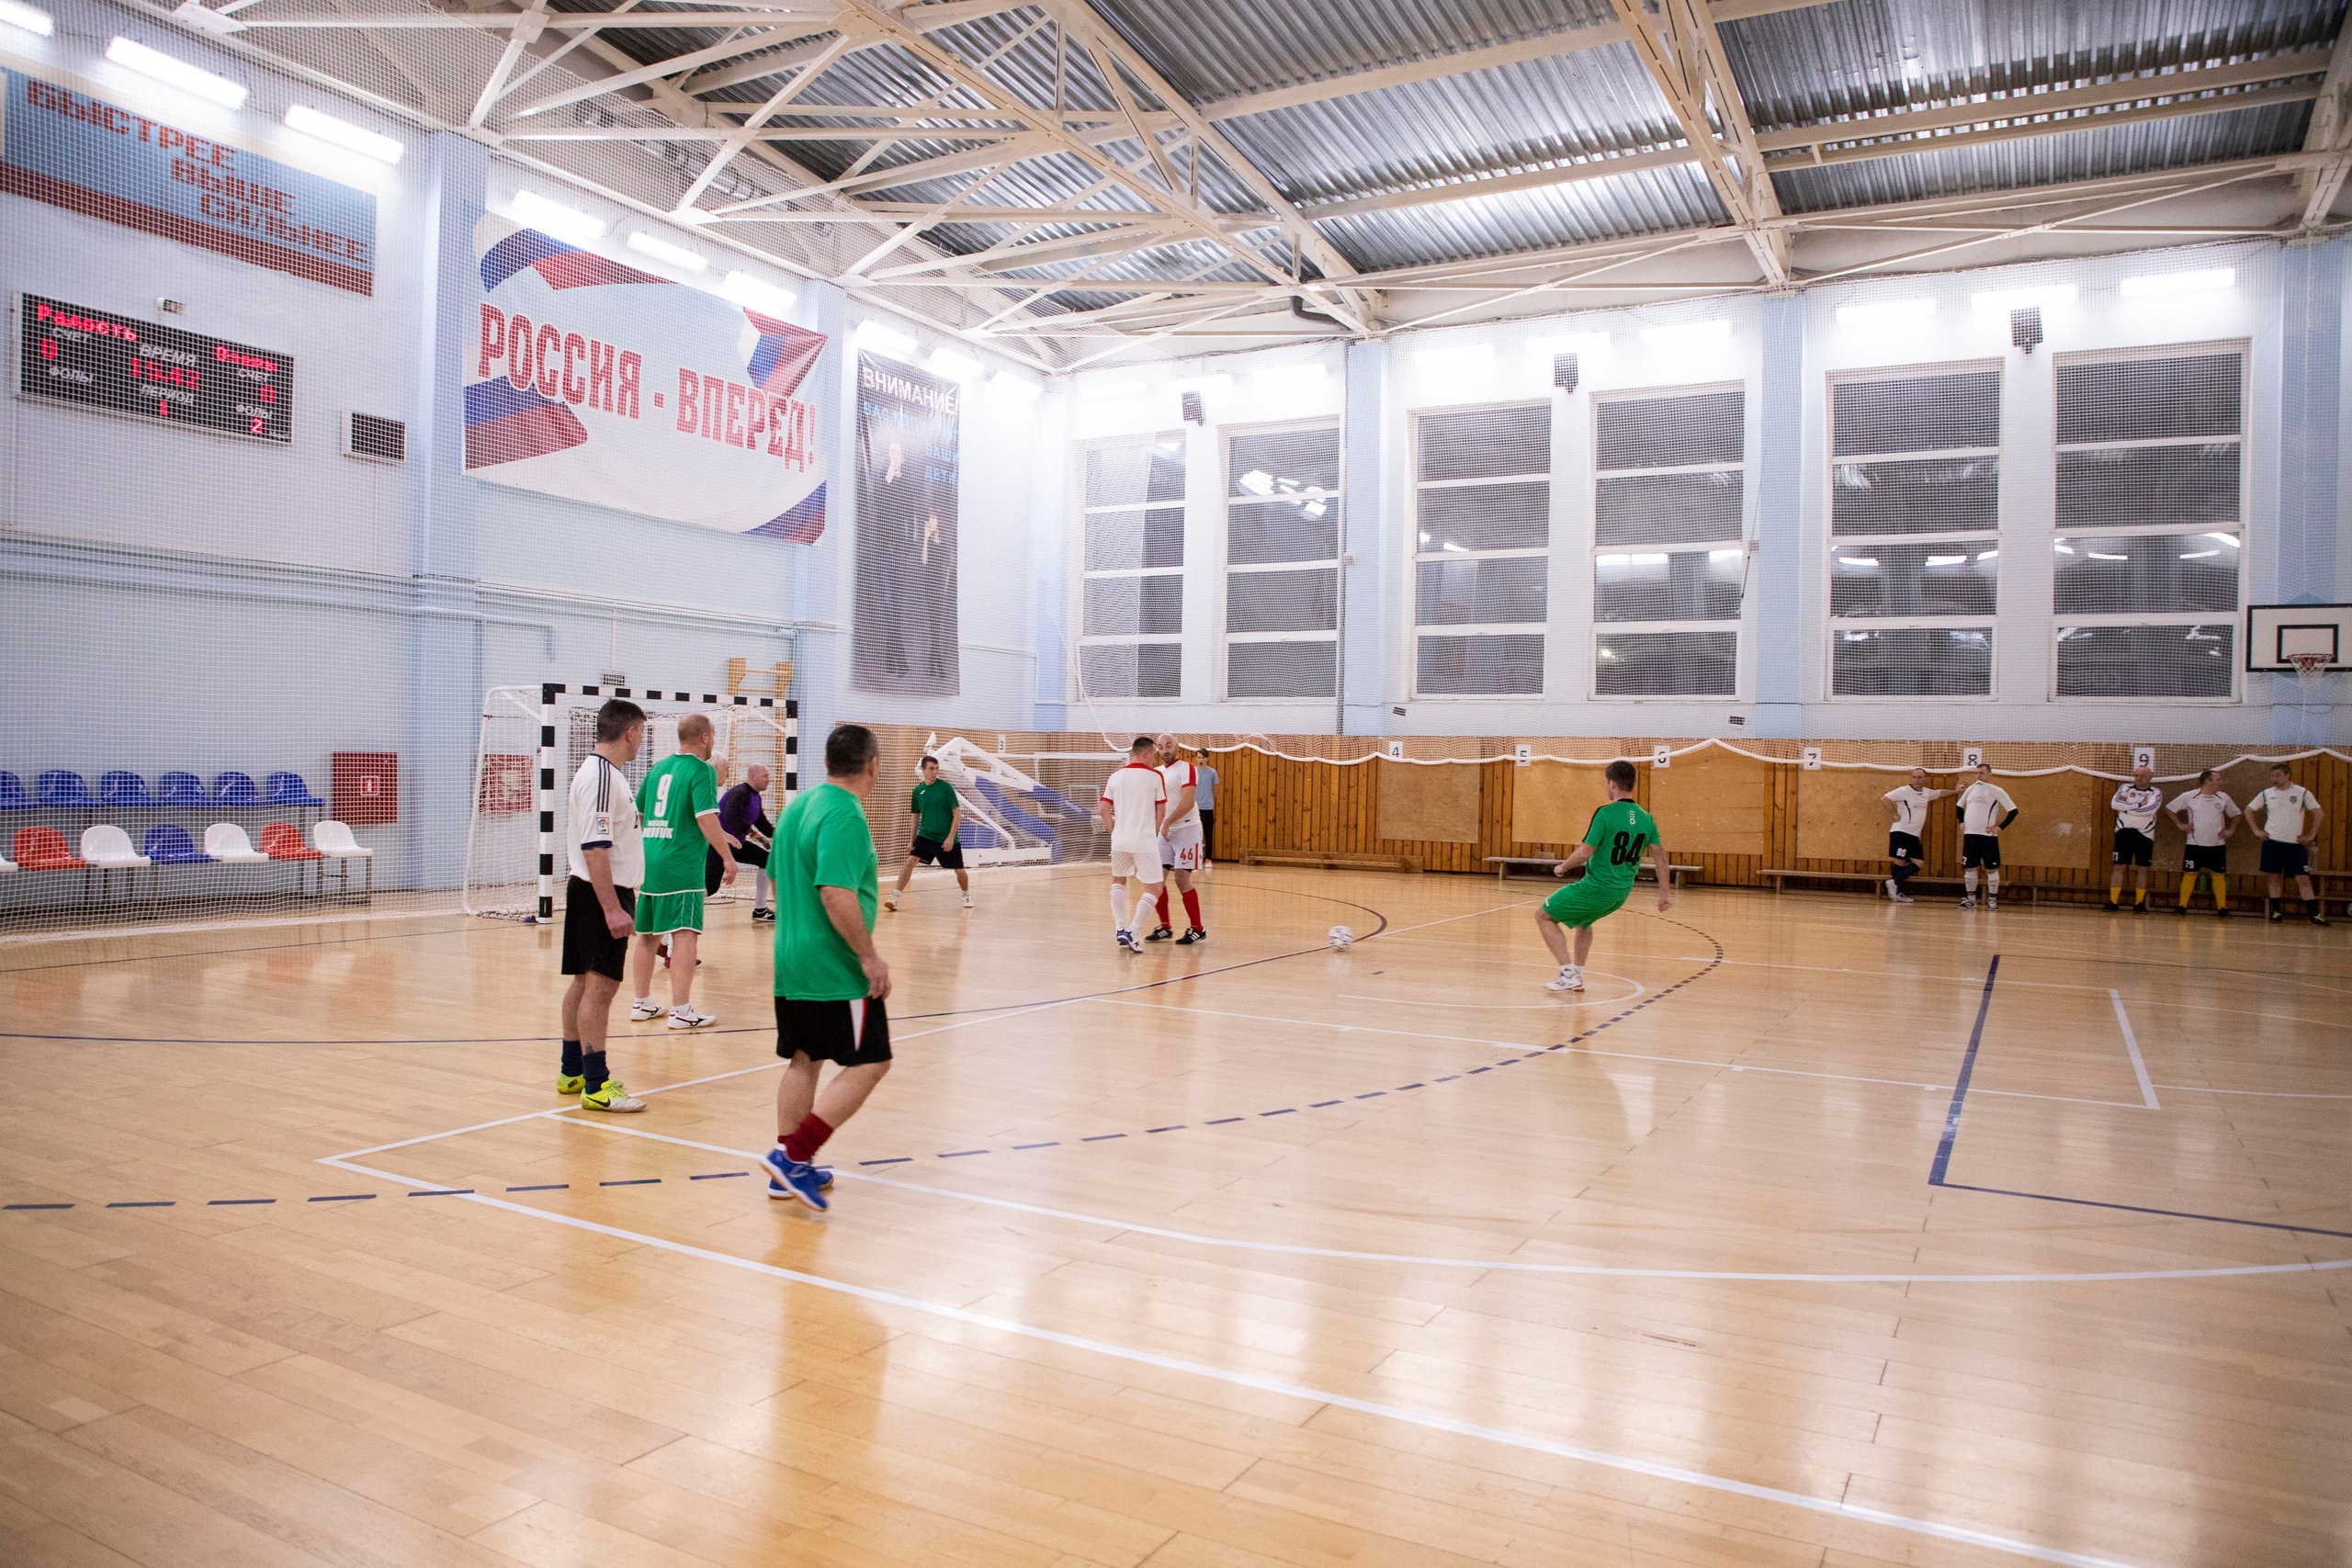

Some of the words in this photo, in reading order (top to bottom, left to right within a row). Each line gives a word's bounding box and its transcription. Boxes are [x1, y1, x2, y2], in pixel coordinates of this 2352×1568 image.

[28, 79, 236, 172] БЫСТРЕЕ
[172, 157, 296, 217] ВЫШЕ
[200, 193, 368, 264] СИЛЬНЕЕ
[40, 338, 58, 359] 0
[140, 344, 197, 367] ВРЕМЯ
[49, 366, 94, 384] ФОЛЫ
[141, 384, 195, 406] ПЕРИОД
[261, 386, 276, 404] 0
[478, 302, 642, 421] РОССИЯ
[675, 367, 817, 473] ВПЕРЕД!
[158, 400, 169, 417] 1
[235, 403, 273, 419] ФОЛЫ
[250, 417, 264, 434] 2
[1391, 746, 1400, 758] 4
[1520, 750, 1528, 762] 5
[1807, 752, 1817, 766] 7
[1967, 753, 1978, 766] 8
[2138, 753, 2150, 767] 9
[653, 773, 673, 818] 9
[1180, 847, 1193, 861] 46
[1610, 830, 1646, 866] 84
